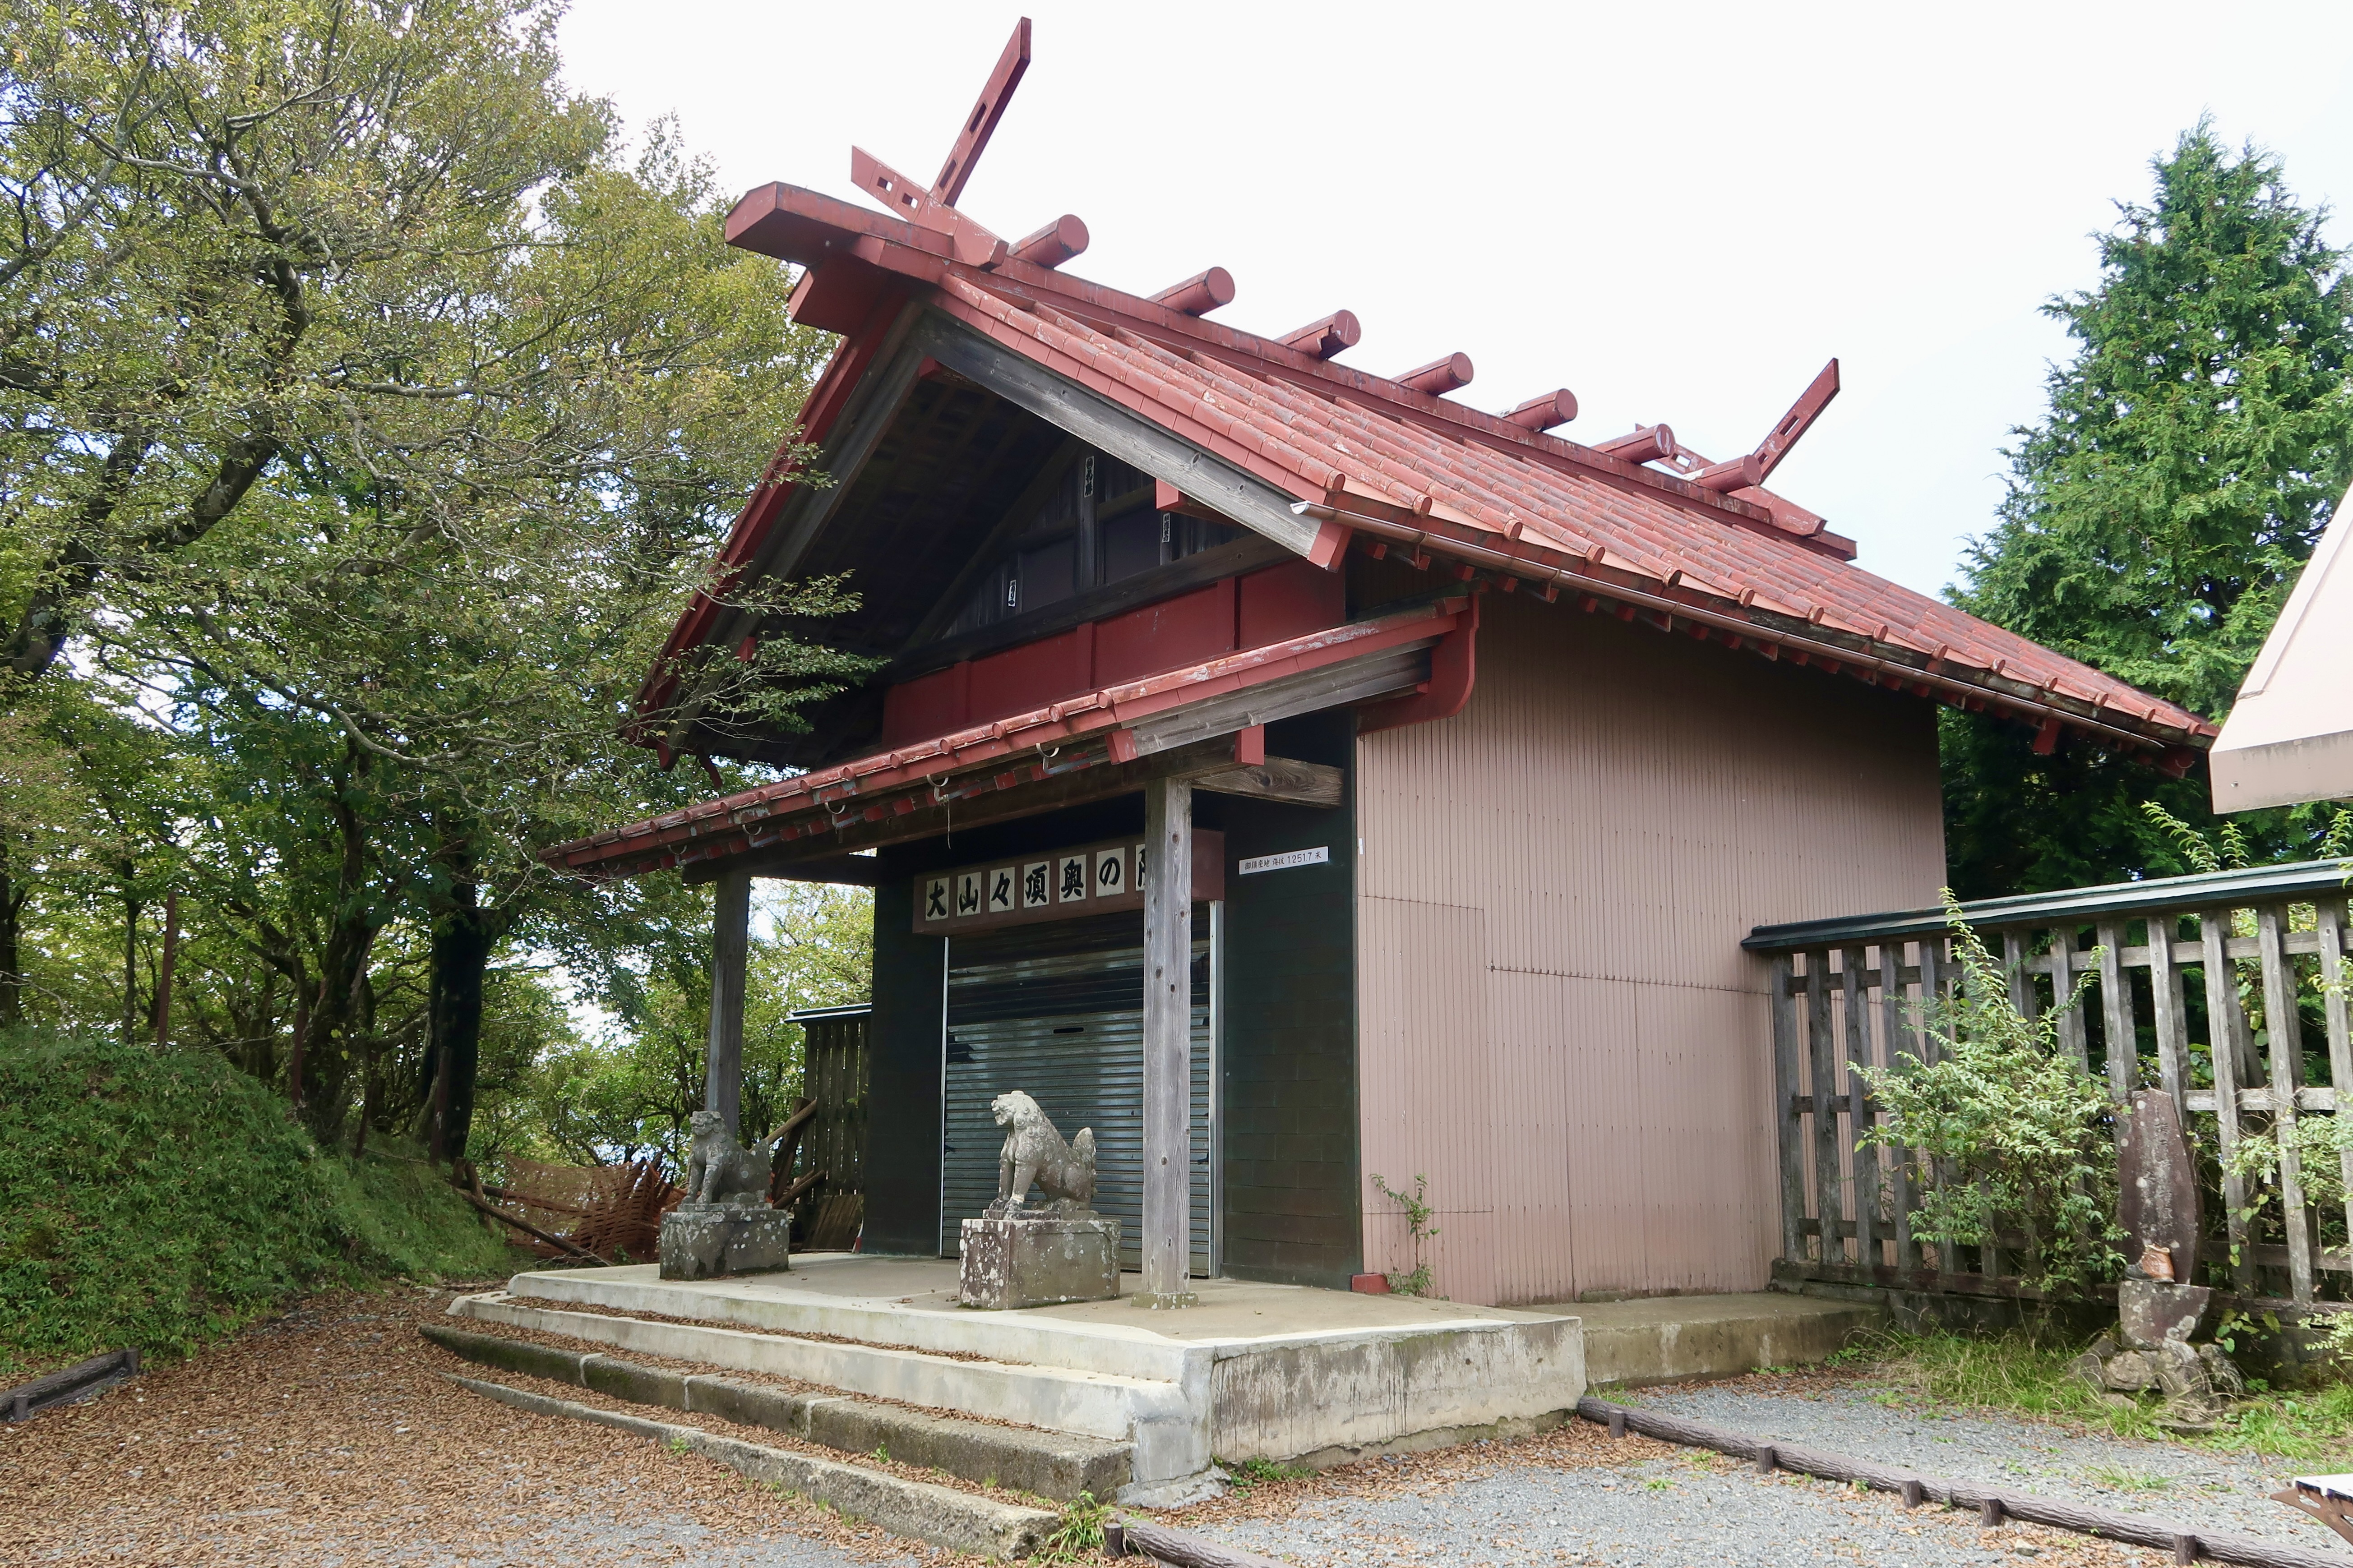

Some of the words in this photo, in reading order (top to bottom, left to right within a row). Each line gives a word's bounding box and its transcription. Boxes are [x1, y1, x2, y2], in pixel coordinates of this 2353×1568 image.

[927, 849, 1145, 917] 大山々頂奥の
